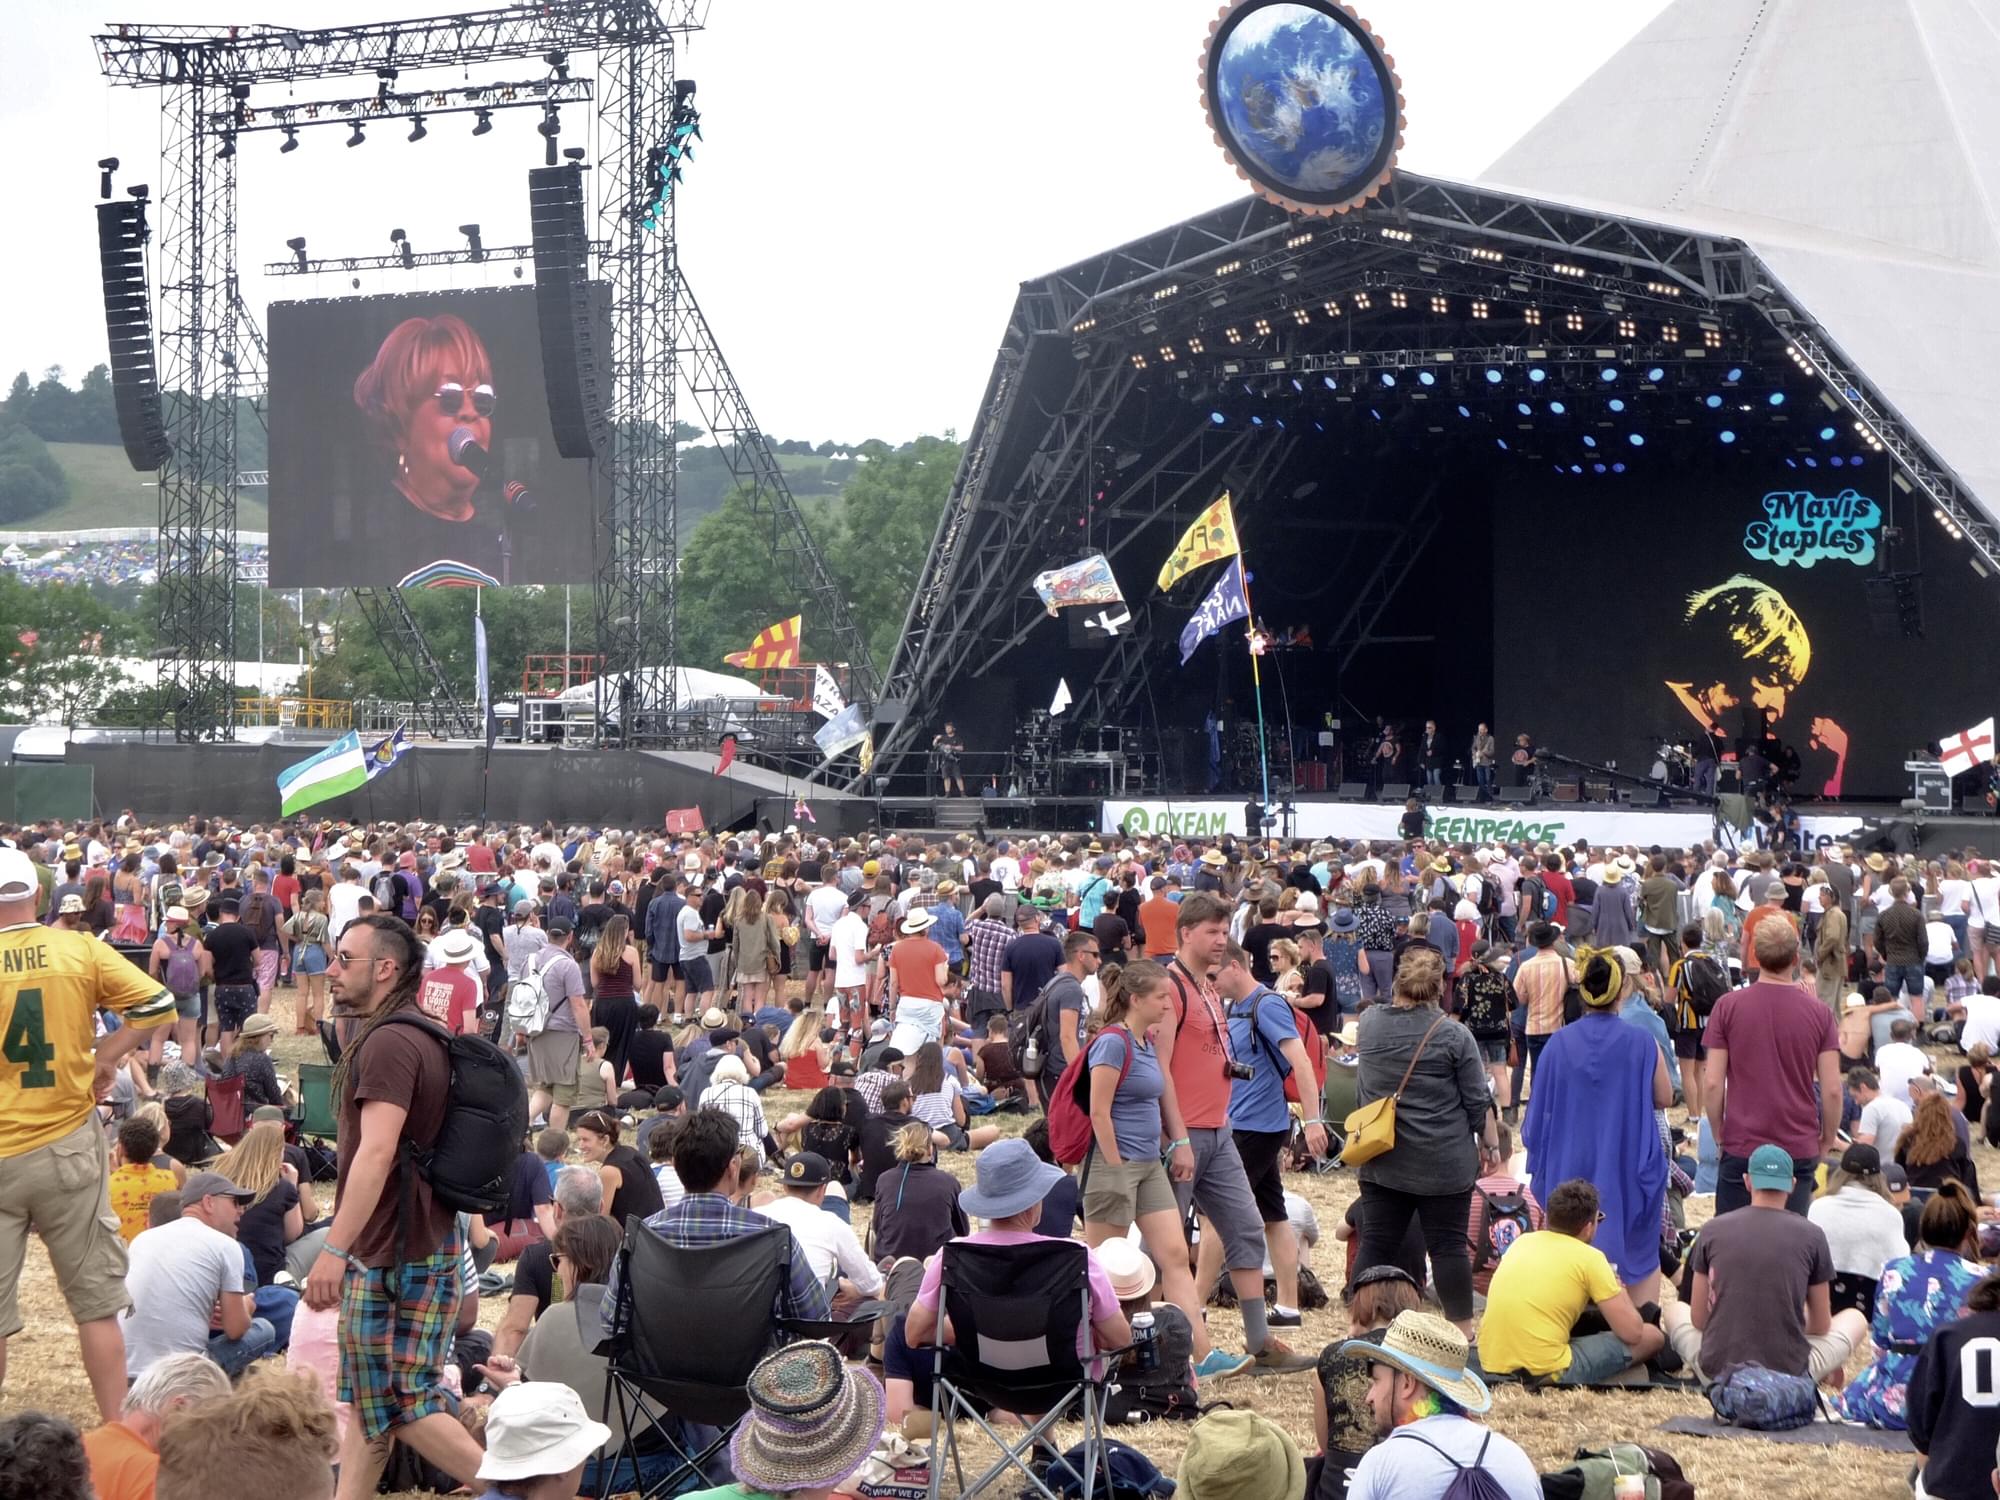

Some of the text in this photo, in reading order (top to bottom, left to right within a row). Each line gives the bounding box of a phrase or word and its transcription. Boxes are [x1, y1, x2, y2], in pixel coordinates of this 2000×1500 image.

[1763, 490, 1873, 528] Mavis
[1744, 520, 1866, 557] Staples
[1155, 811, 1228, 836] OXFAM
[0, 944, 49, 973] AVRE
[3, 988, 56, 1089] 4
[872, 1488, 896, 1497] WHAT
[898, 1489, 912, 1497] WE
